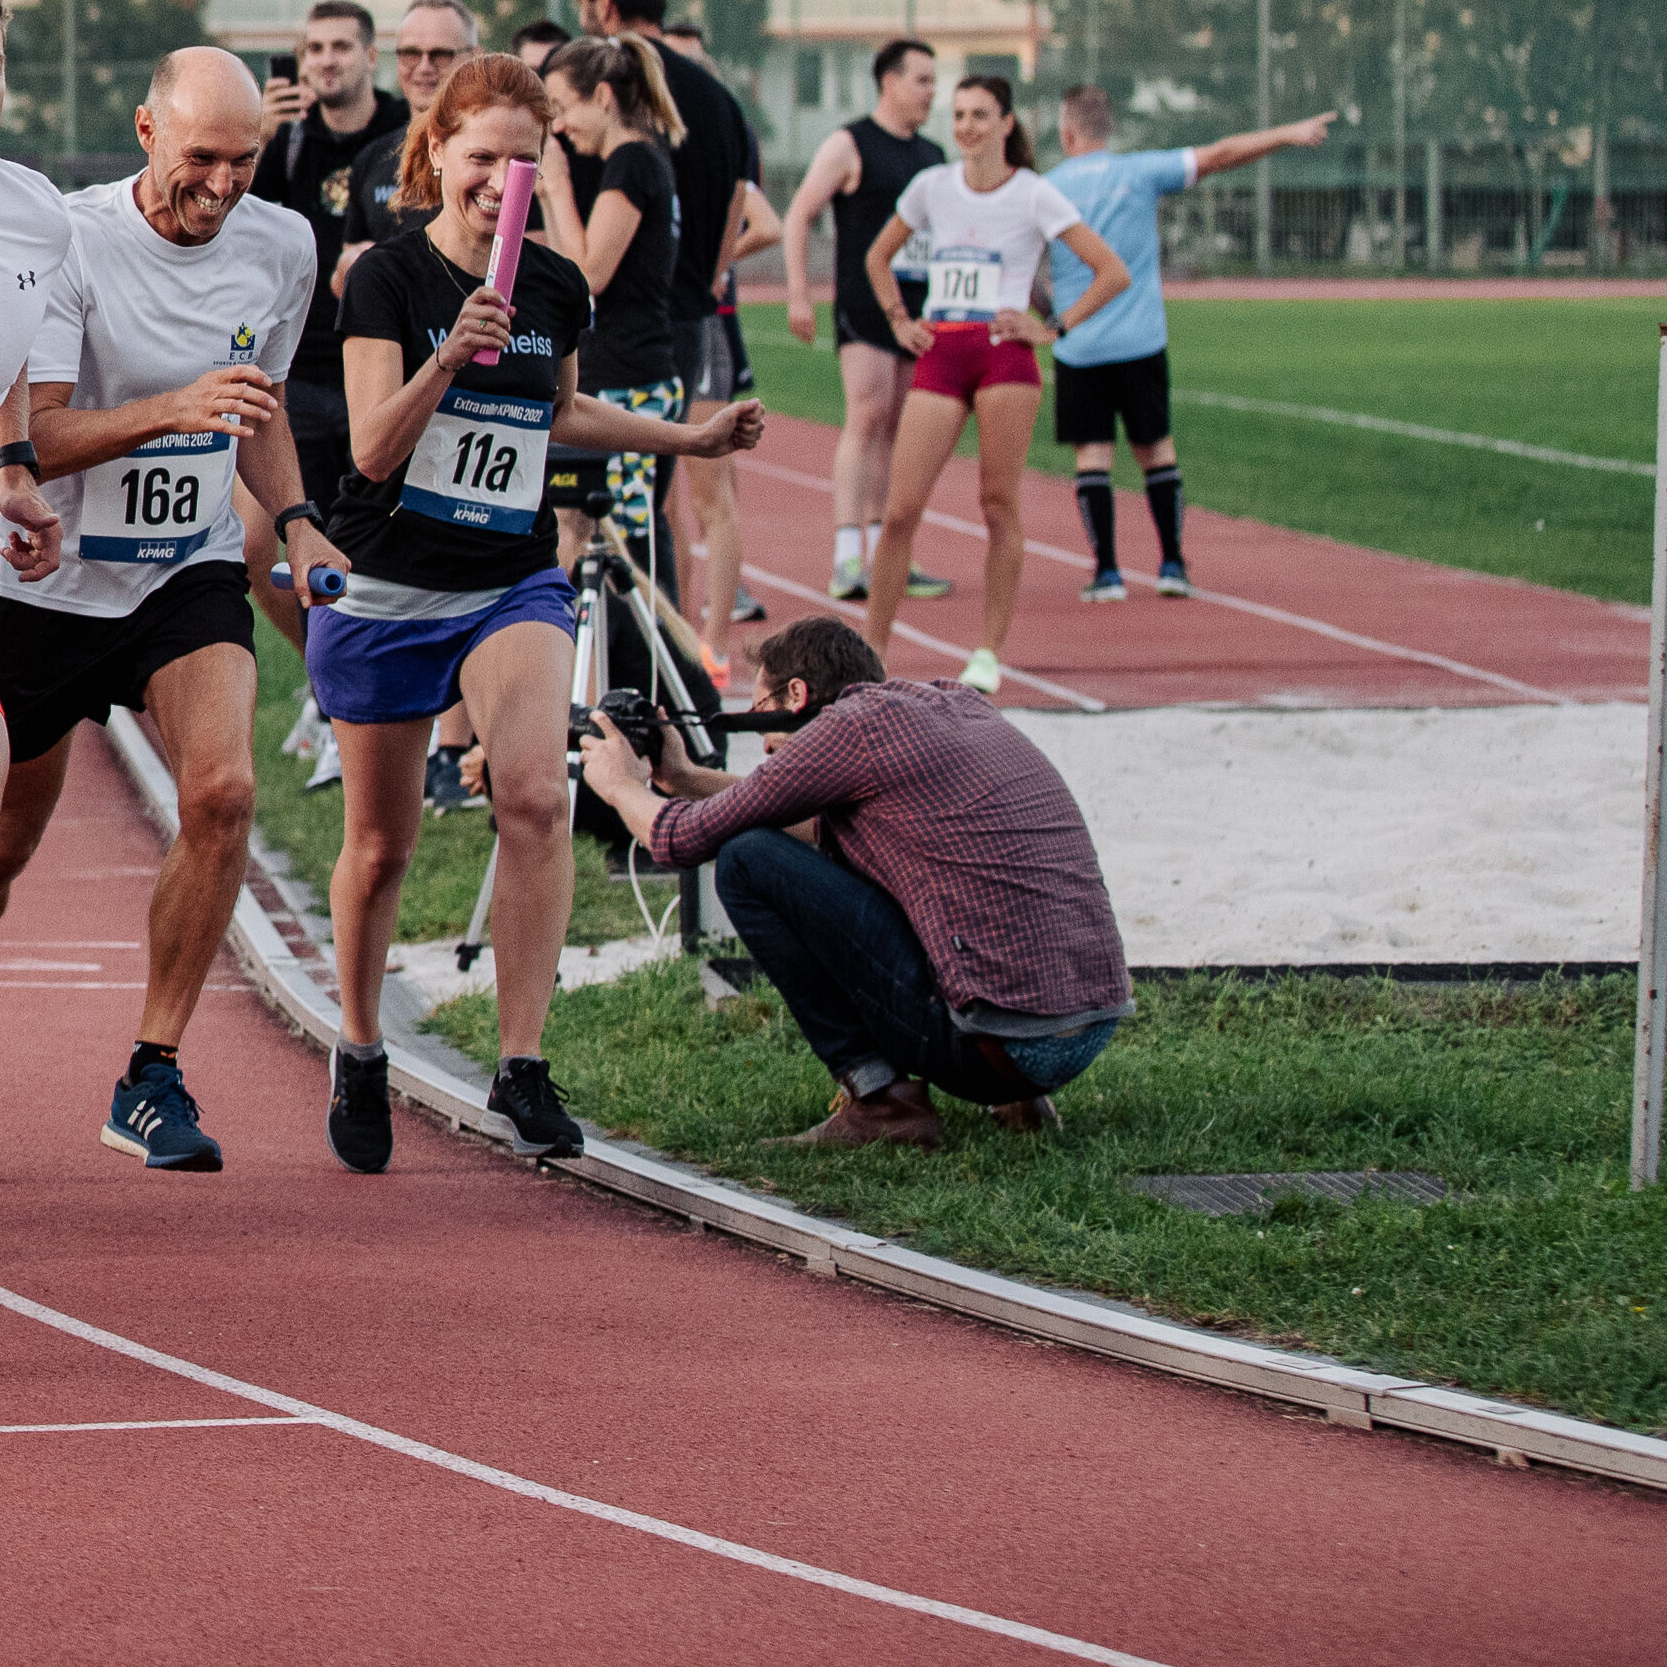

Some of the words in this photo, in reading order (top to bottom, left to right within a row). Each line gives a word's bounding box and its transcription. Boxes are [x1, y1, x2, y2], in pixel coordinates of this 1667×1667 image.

[453, 397, 481, 414] Extra
[497, 403, 525, 421] KPMG
[522, 407, 545, 424] 2022
[161, 433, 190, 449] KPMG
[190, 431, 214, 447] 2022
[451, 430, 518, 493] 11a
[120, 466, 200, 526] 16a
[453, 508, 491, 525] KPMG
[136, 547, 175, 559] KPMG
